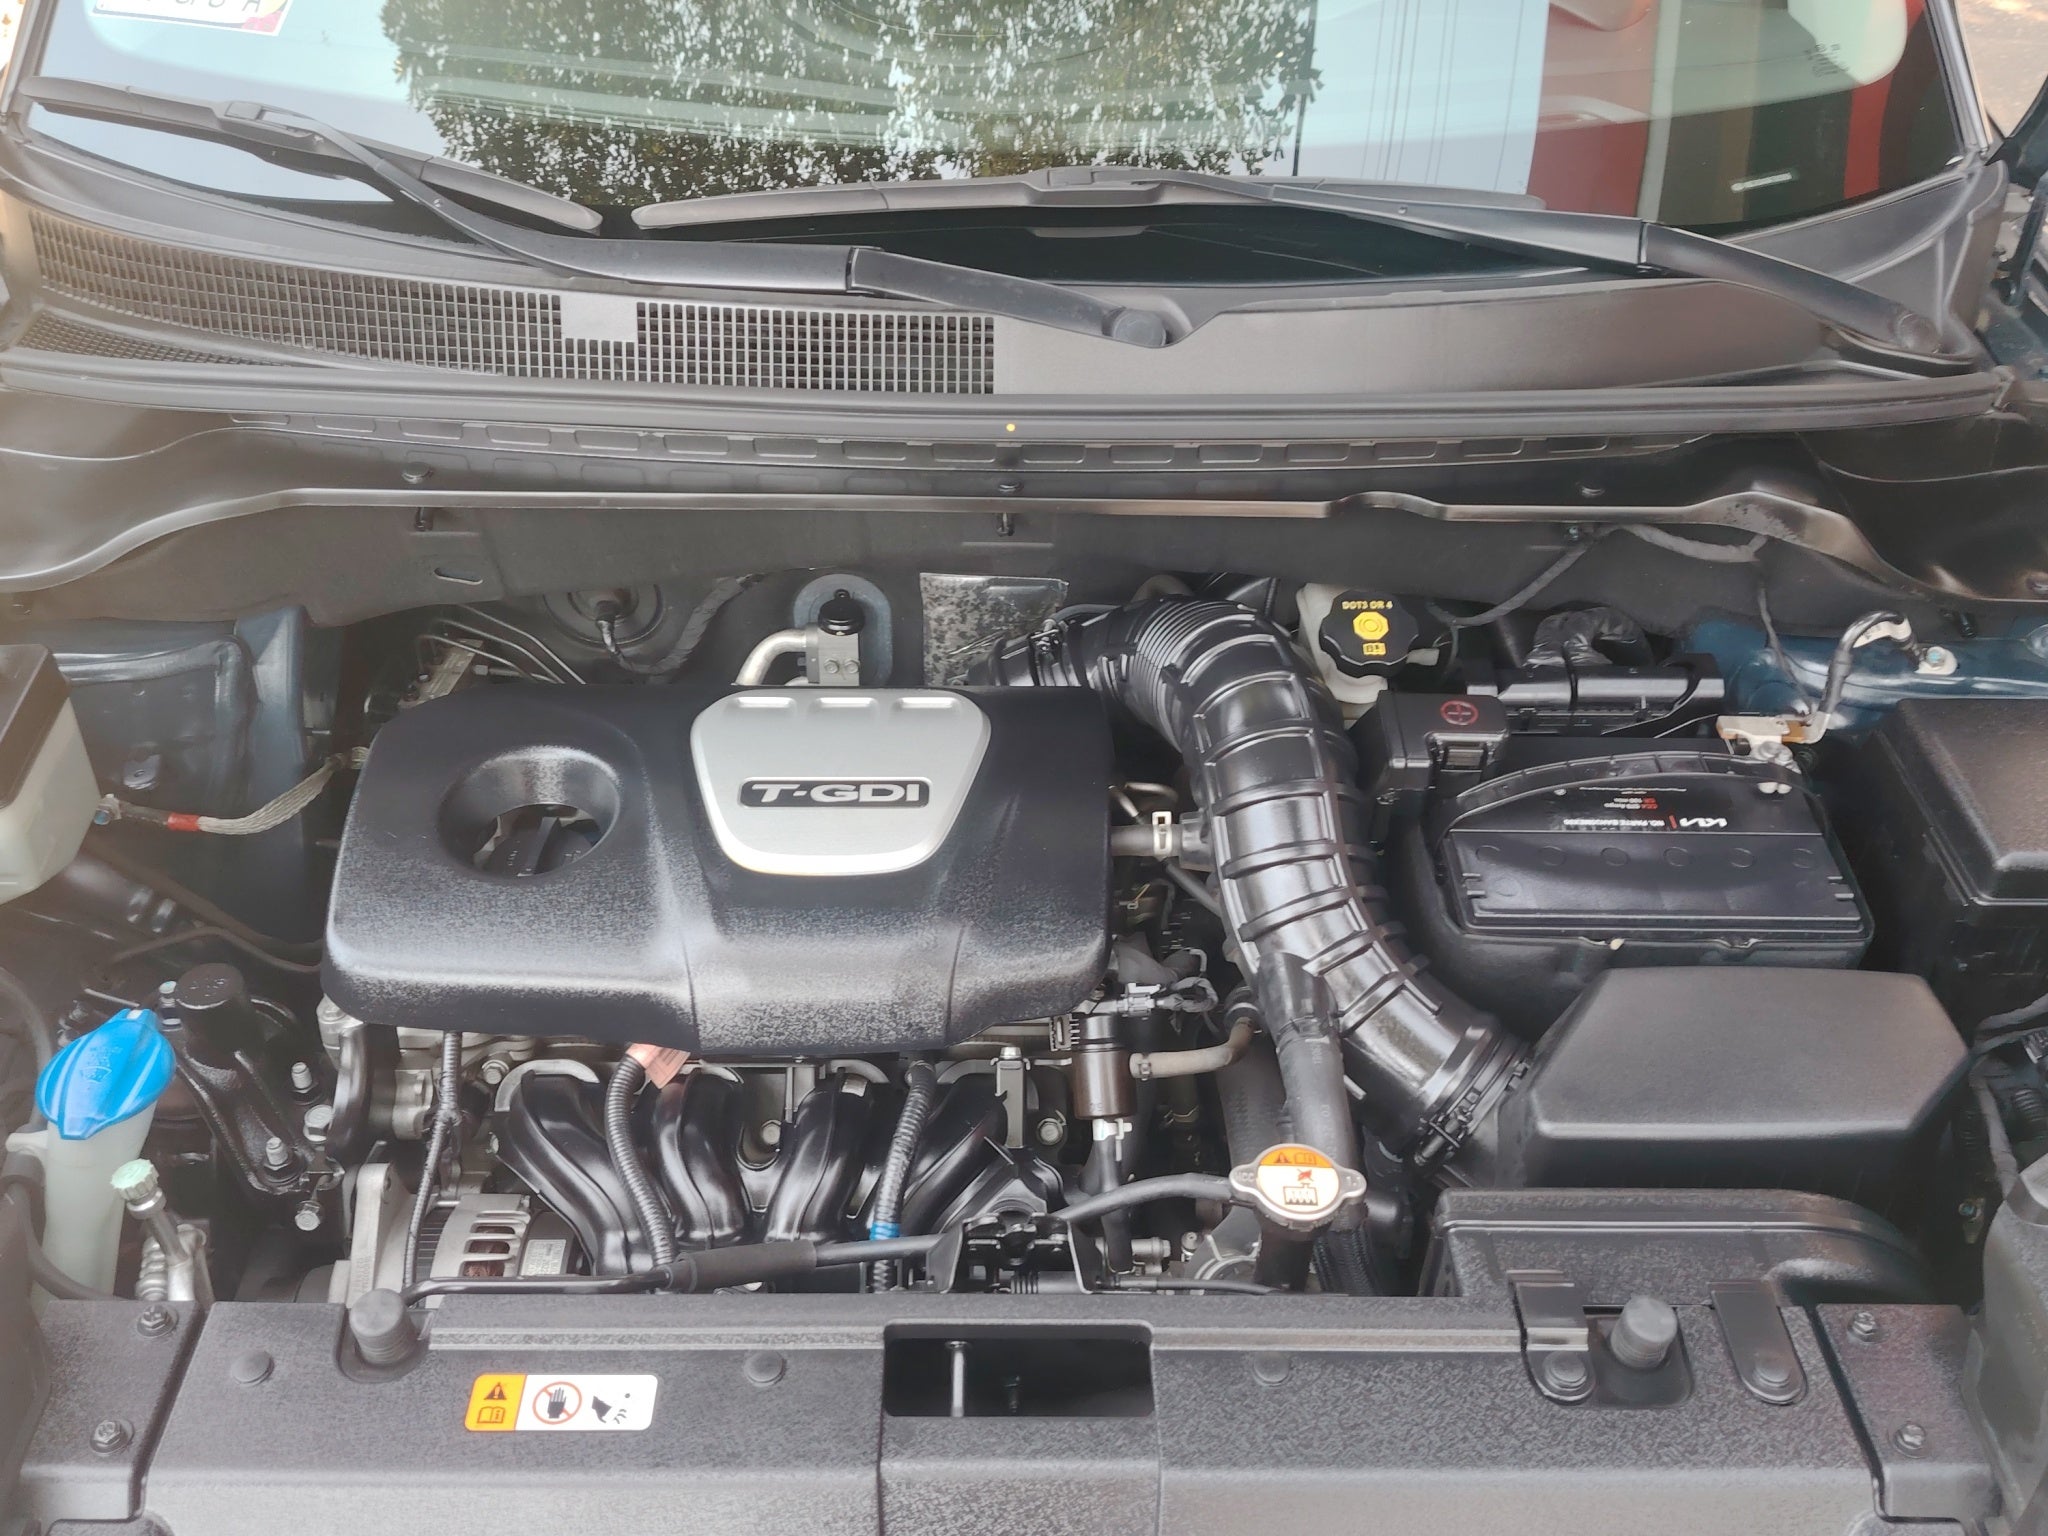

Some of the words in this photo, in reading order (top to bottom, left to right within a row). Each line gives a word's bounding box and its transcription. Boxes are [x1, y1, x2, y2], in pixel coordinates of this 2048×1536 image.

[1342, 601, 1368, 609] DOT3
[1370, 601, 1384, 609] OR
[1386, 601, 1393, 609] 4
[751, 783, 920, 803] T-GDI
